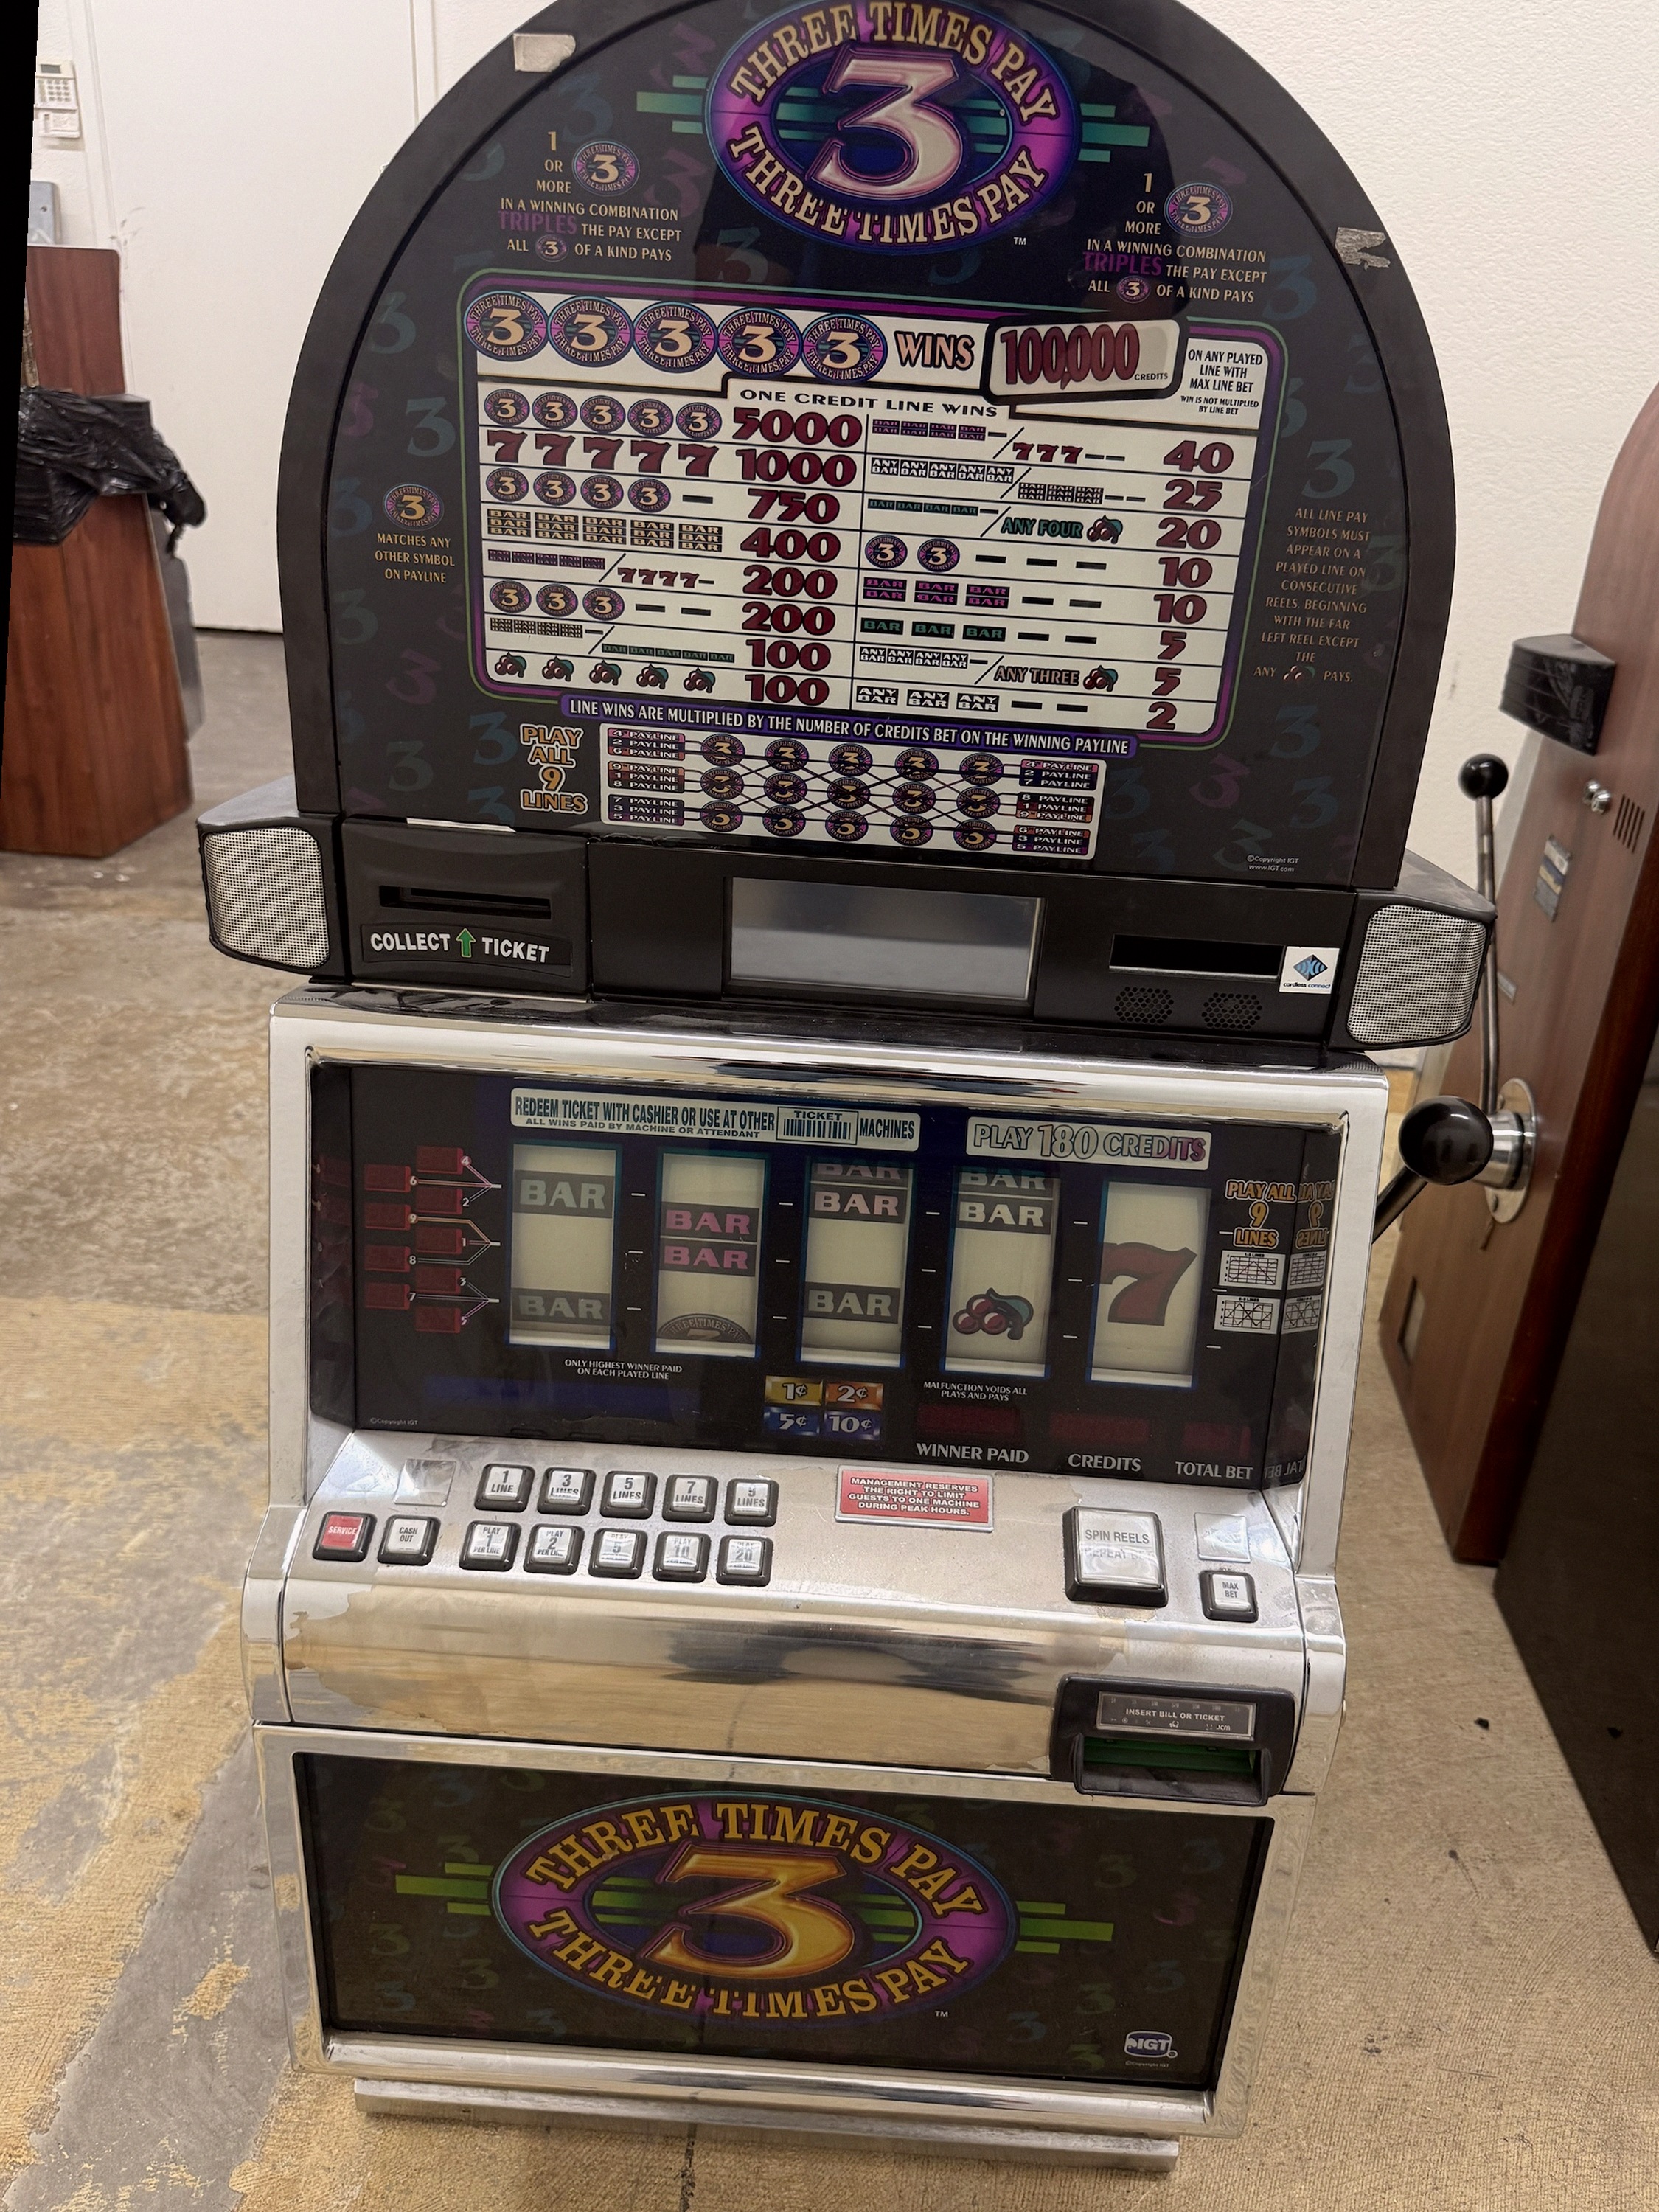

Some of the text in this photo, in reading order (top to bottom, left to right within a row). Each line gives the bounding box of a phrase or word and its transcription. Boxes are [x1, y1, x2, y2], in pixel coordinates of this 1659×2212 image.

[728, 2, 1057, 124] THREE TIMES PAY
[805, 39, 963, 201] 3
[548, 131, 557, 151] 1
[545, 159, 563, 173] OR
[536, 179, 571, 193] MORE
[728, 126, 1048, 243] THREE TIMES PAY
[501, 198, 678, 221] IN A WINNING COMBINATION
[498, 210, 682, 242] TRIPLES THE PAY EXCEPT
[507, 239, 672, 262] ALL OF A KIND PAYS
[894, 323, 1168, 390] WINS 100,000 CREDITS
[1188, 349, 1263, 365] ON ANY PLAYED
[1200, 364, 1247, 378] LINE WITH
[1189, 378, 1253, 392] MAX LINE BET
[740, 389, 998, 417] ONE CREDIT LINE WINS
[1220, 398, 1259, 408] MULTIPLIED
[733, 408, 862, 447] 5000
[736, 448, 857, 487] 1000
[1164, 440, 1234, 474] 40
[748, 488, 840, 524] 750
[1163, 479, 1223, 512] 25
[1001, 517, 1083, 539] ANY FOUR
[1156, 517, 1222, 551] 20
[377, 532, 451, 549] MATCHES ANY
[740, 527, 841, 563] 400
[375, 550, 455, 566] OTHER SYMBOL
[384, 568, 446, 583] ON PAYLINE
[742, 565, 838, 599] 200
[1158, 556, 1214, 588] 10
[742, 601, 835, 636] 200
[1153, 593, 1207, 625] 10
[745, 639, 831, 672] 100
[1157, 630, 1187, 661] 5
[994, 666, 1080, 686] ANY THREE
[1152, 667, 1182, 696] 5
[745, 673, 830, 706] 100
[571, 699, 1129, 754] LINE WINS ARE MULTIPLIED BY THE NUMBER OF CREDITS BET ON THE WINNING PAYLINE
[1147, 701, 1178, 731] 2
[521, 724, 583, 748] PLAY
[528, 745, 576, 768] ALL
[539, 766, 566, 790] 9
[521, 789, 588, 814] LINES
[370, 932, 550, 963] COLLECT TICKET
[515, 1096, 915, 1139] REDEEM TICKET WITH CASHIER OR USE AT OTHER TICKET MACHINES
[973, 1124, 1207, 1161] PLAY 180 CREDITS
[1225, 1180, 1297, 1203] PLAY ALL
[1249, 1200, 1269, 1228] 9
[1233, 1227, 1279, 1248] LINES
[923, 1381, 1027, 1395] MALFUNCTION VOIDS ALL
[941, 1390, 1009, 1402] PLAYS AND PAYS
[916, 1443, 1029, 1464] WINNER PAID
[1068, 1453, 1141, 1472] CREDITS
[1175, 1461, 1253, 1481] TOTAL BET
[851, 1478, 978, 1492] MANAGEMENT RESERVES
[887, 1488, 918, 1496] RIGHT
[849, 1493, 889, 1502] GUESTS
[908, 1497, 930, 1505] ONE
[933, 1498, 980, 1508] MACHINE
[858, 1502, 898, 1511] DURING
[931, 1506, 970, 1516] HOURS.
[328, 1526, 358, 1535] SERVICE
[1085, 1529, 1150, 1544] SPIN REELS
[1222, 1582, 1239, 1590] MAX
[1225, 1590, 1237, 1598] BET
[1125, 1708, 1225, 1722] INSERT BILL OR TICKET
[526, 1803, 985, 1917] THREE TIMES PAY
[641, 1840, 855, 1980] 3
[529, 1908, 970, 2018] THREE TIMES PAY
[1137, 2038, 1170, 2051] IGT
